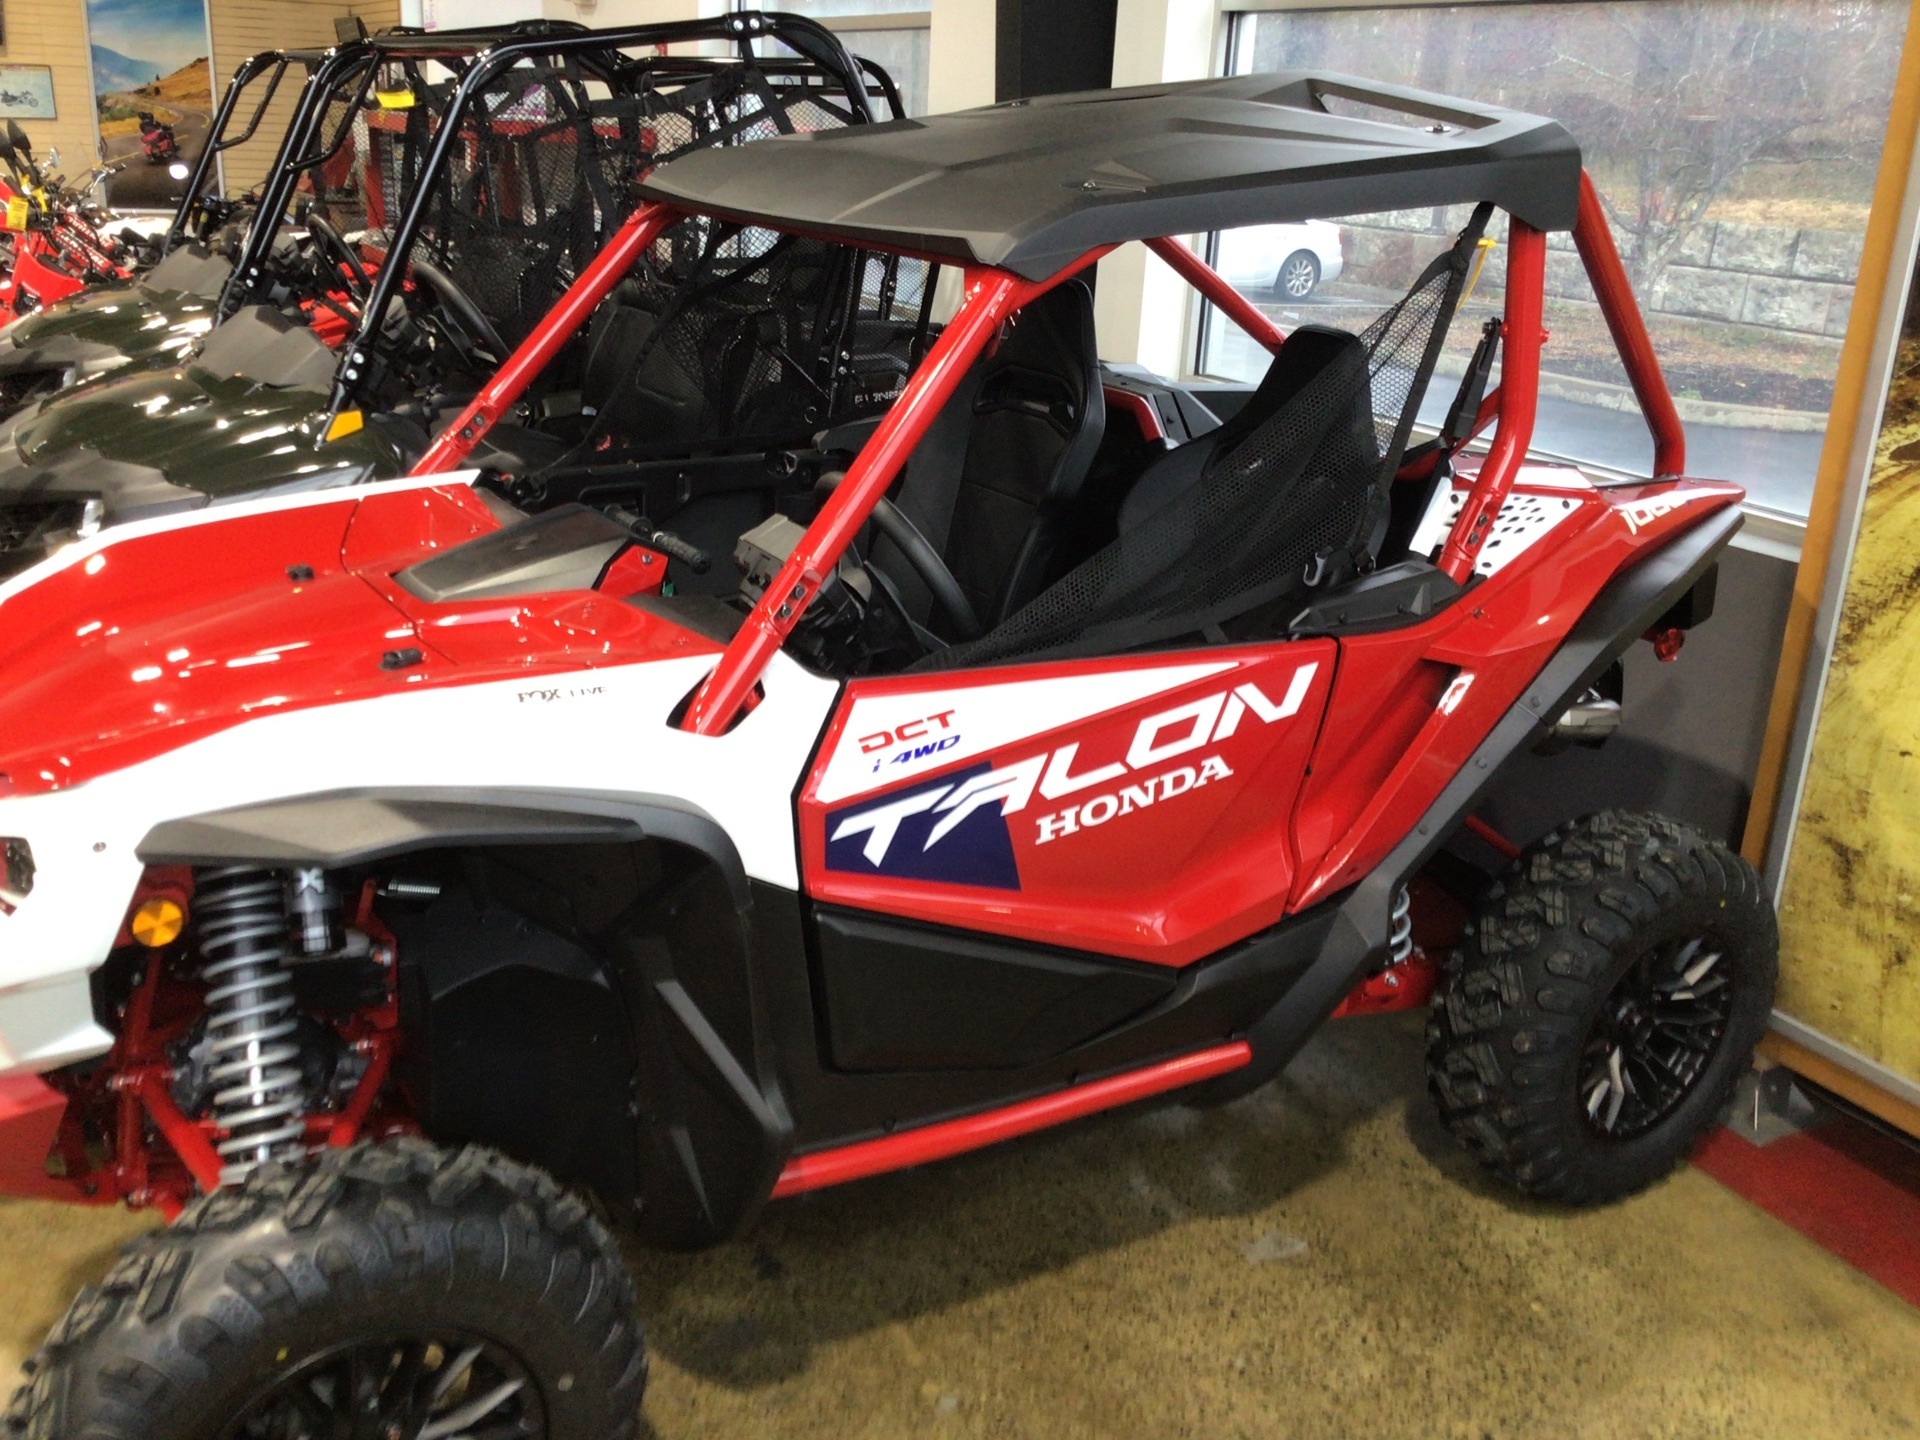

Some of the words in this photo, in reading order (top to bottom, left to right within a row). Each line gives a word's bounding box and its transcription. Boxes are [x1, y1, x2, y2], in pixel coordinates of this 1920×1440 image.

[830, 661, 1319, 868] TALON
[858, 709, 955, 754] DCT
[1035, 755, 1234, 846] HONDA
